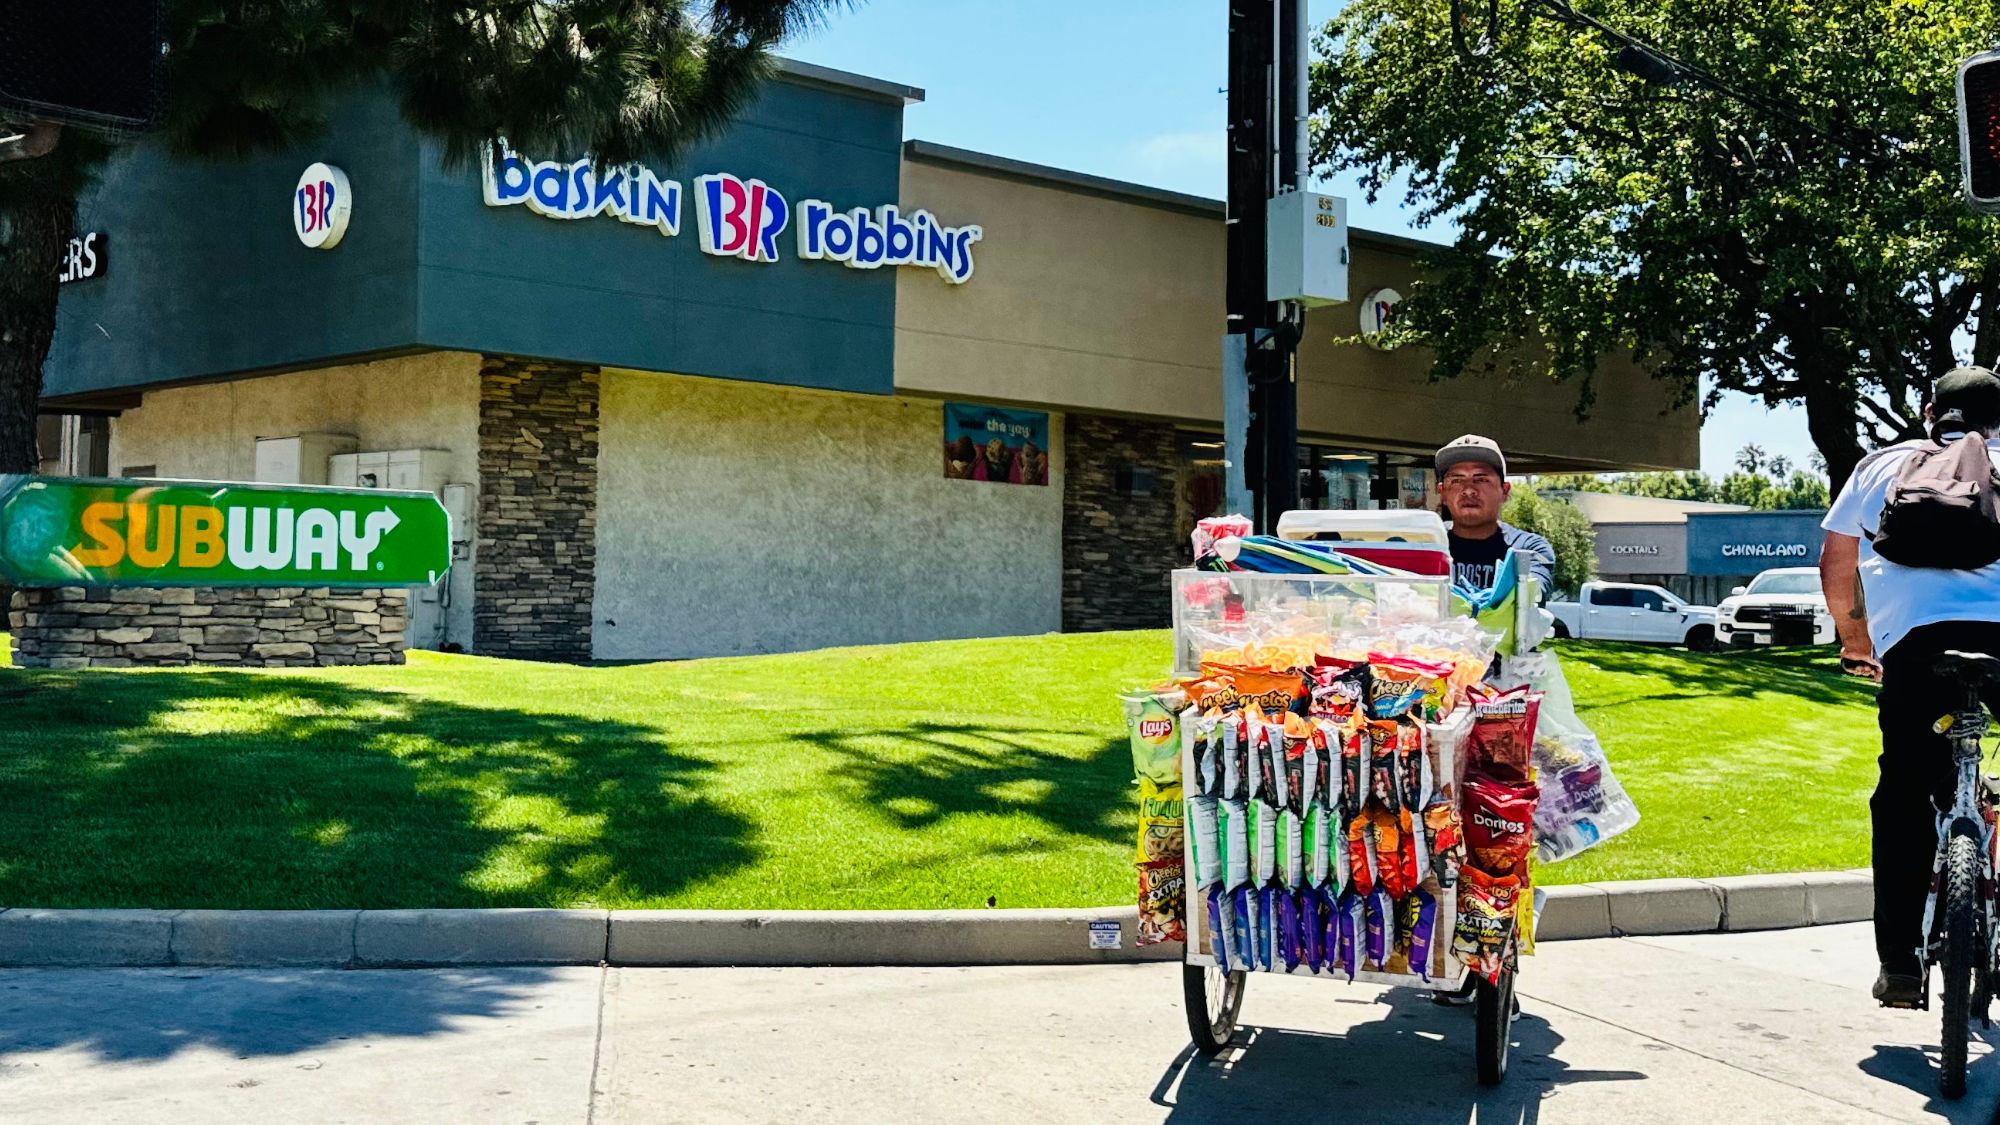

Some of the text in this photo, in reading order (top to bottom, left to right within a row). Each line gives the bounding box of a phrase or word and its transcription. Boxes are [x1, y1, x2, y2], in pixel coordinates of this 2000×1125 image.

[298, 180, 335, 233] BR
[497, 148, 971, 278] baskin BR robbins
[987, 418, 1006, 432] the
[69, 501, 401, 571] SUBWAY
[1609, 545, 1659, 555] COCKTAILS
[1721, 543, 1807, 557] CHINALAND
[1452, 562, 1494, 588] POST
[1370, 679, 1418, 699] Cheet
[1143, 797, 1183, 819] Funyu
[1474, 813, 1525, 834] Doritos
